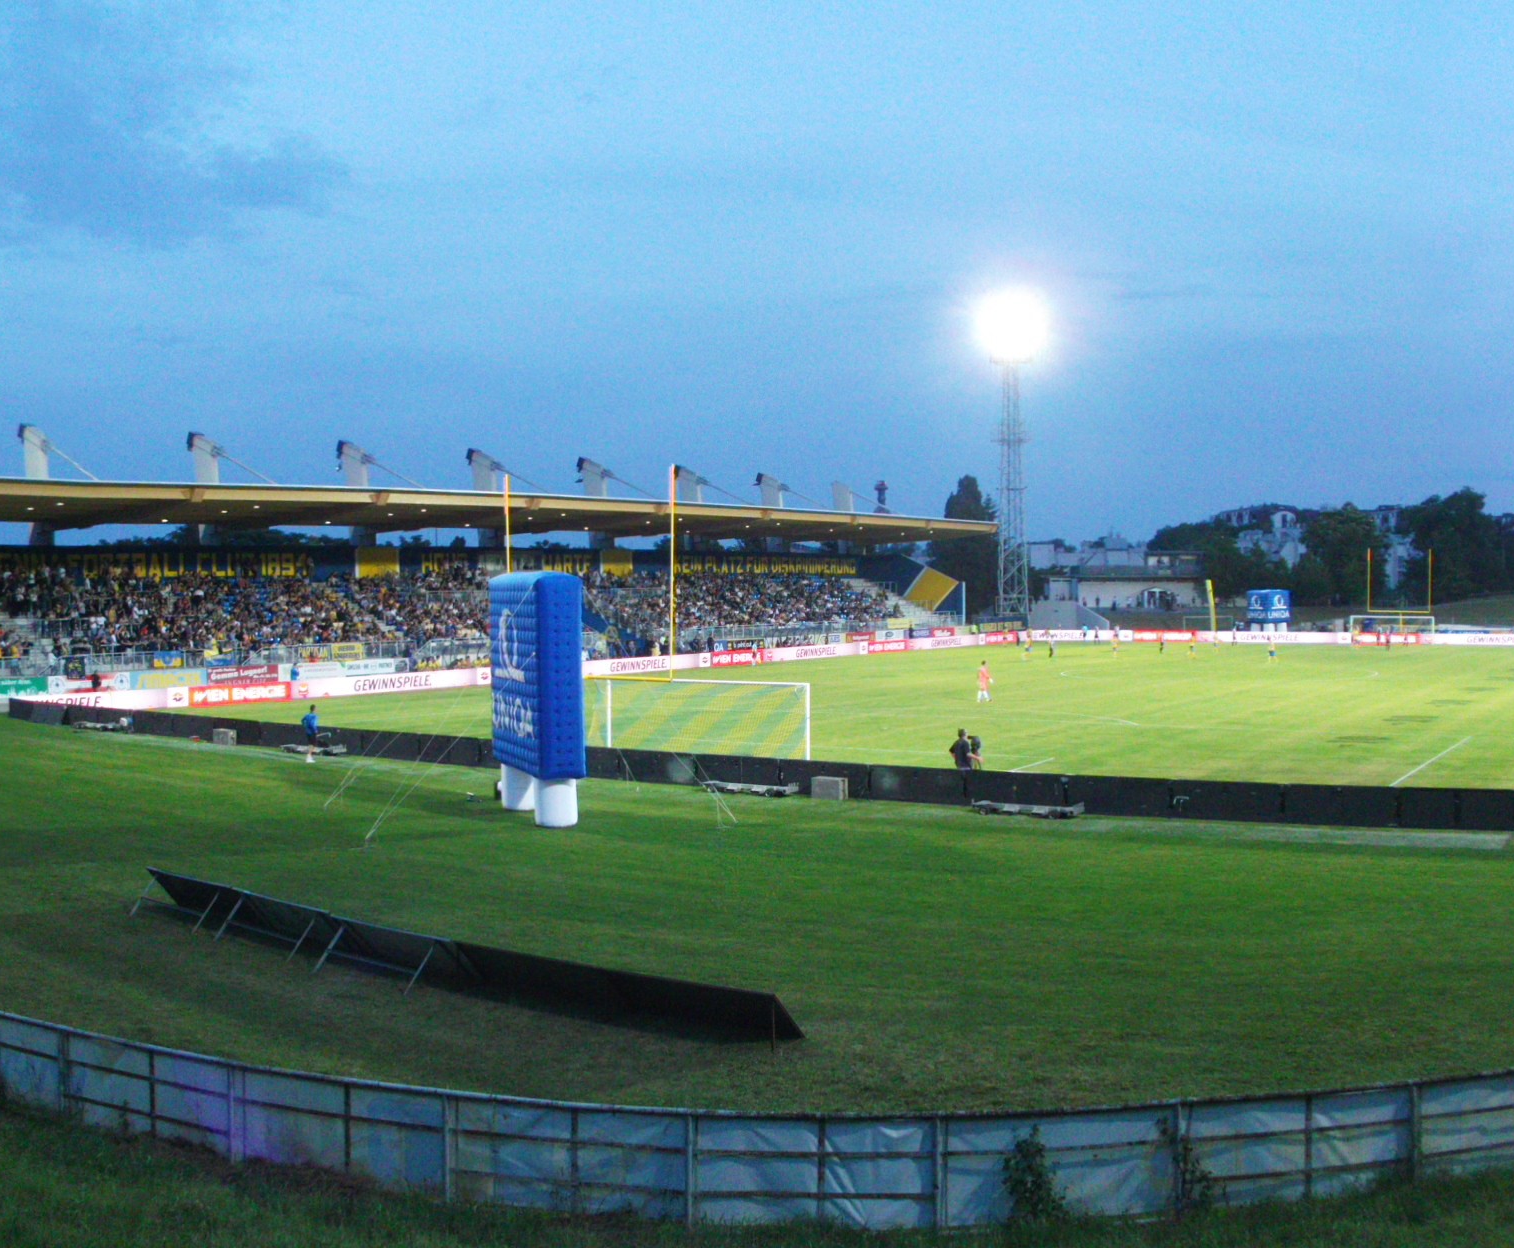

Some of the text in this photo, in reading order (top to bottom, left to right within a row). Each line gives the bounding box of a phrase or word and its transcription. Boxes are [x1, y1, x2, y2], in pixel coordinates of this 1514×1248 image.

[704, 555, 745, 574] PLATZ
[610, 658, 668, 672] GEWINNSPIELE.
[712, 653, 731, 664] WIEN
[353, 674, 432, 692] GEWINNSPIELE.
[193, 684, 287, 704] WIEN ENERGIE
